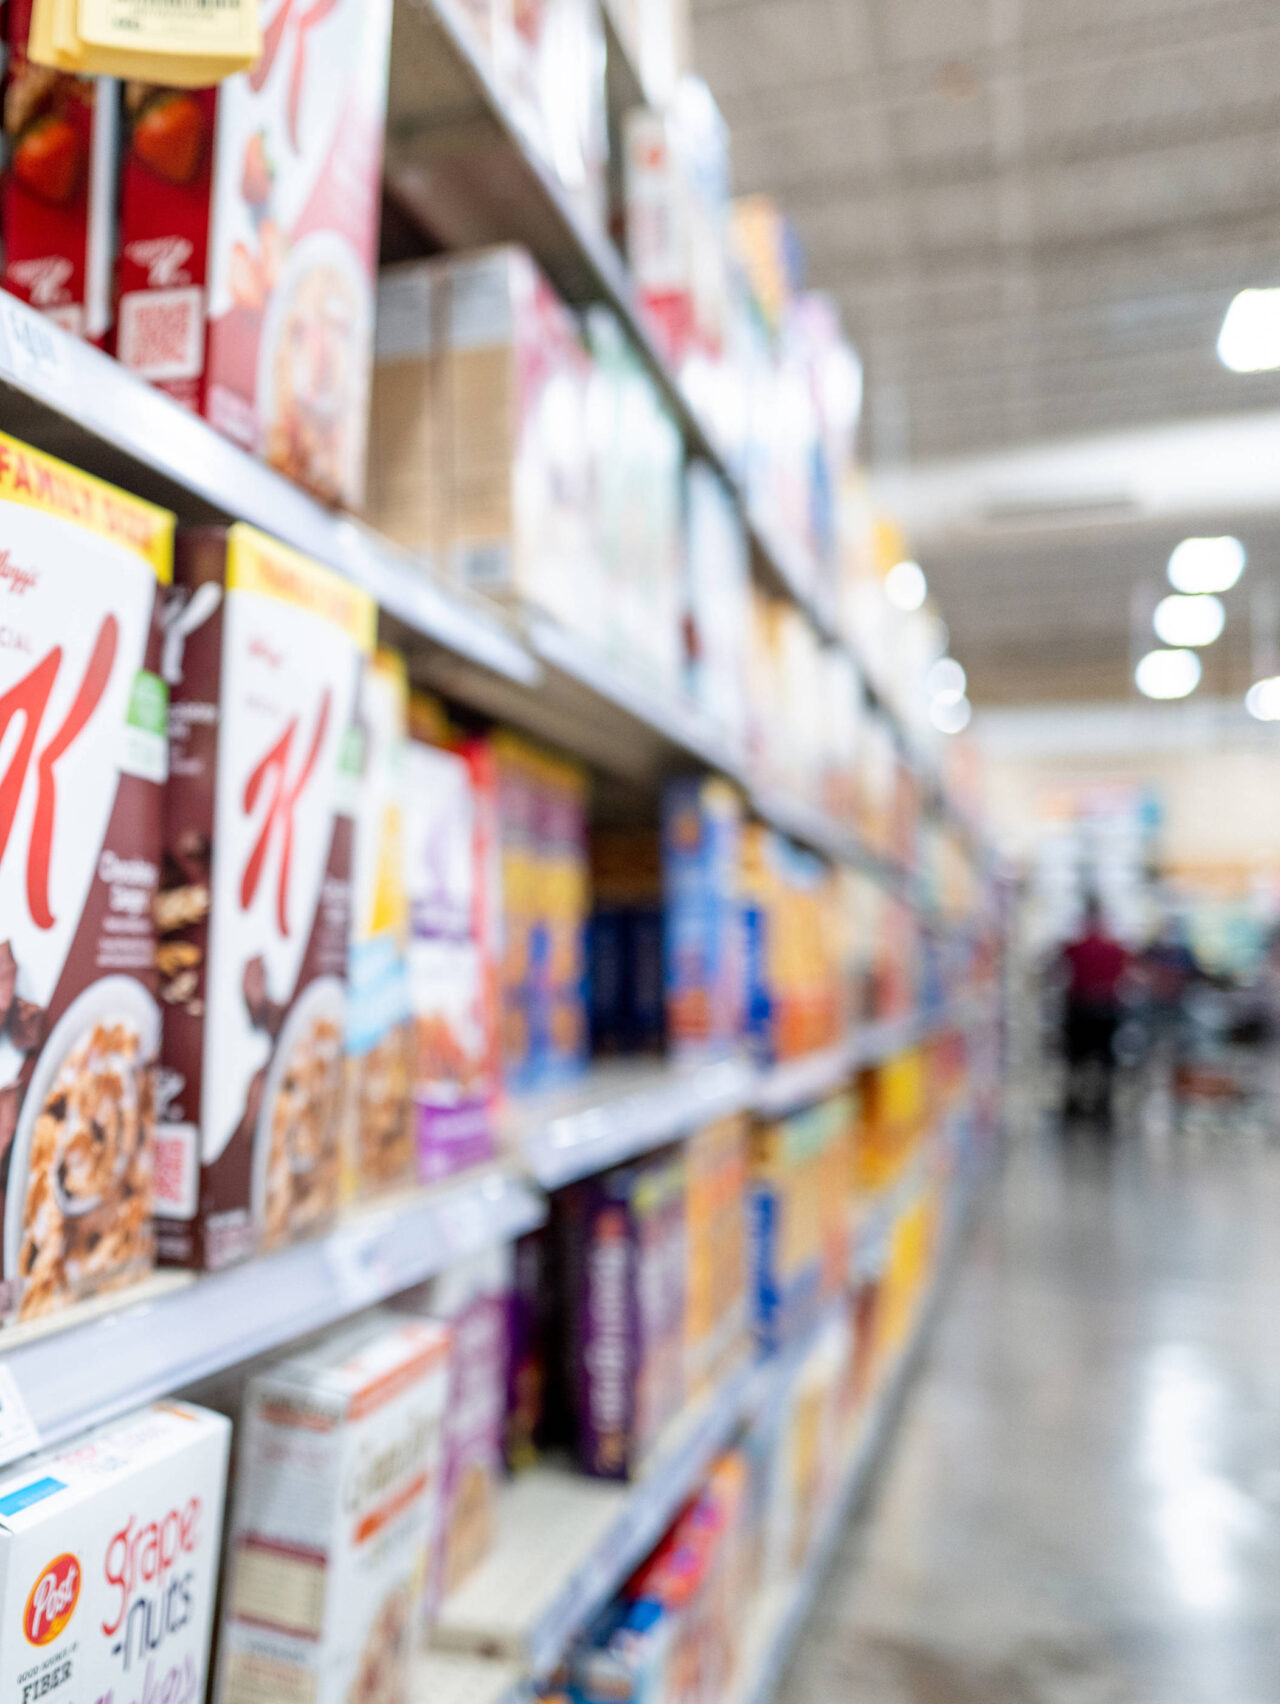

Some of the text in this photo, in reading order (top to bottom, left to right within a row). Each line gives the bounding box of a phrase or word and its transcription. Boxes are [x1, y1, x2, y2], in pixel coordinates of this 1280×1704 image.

[31, 1563, 79, 1638] Post
[101, 1496, 202, 1637] grape
[22, 1659, 72, 1704] FIBER
